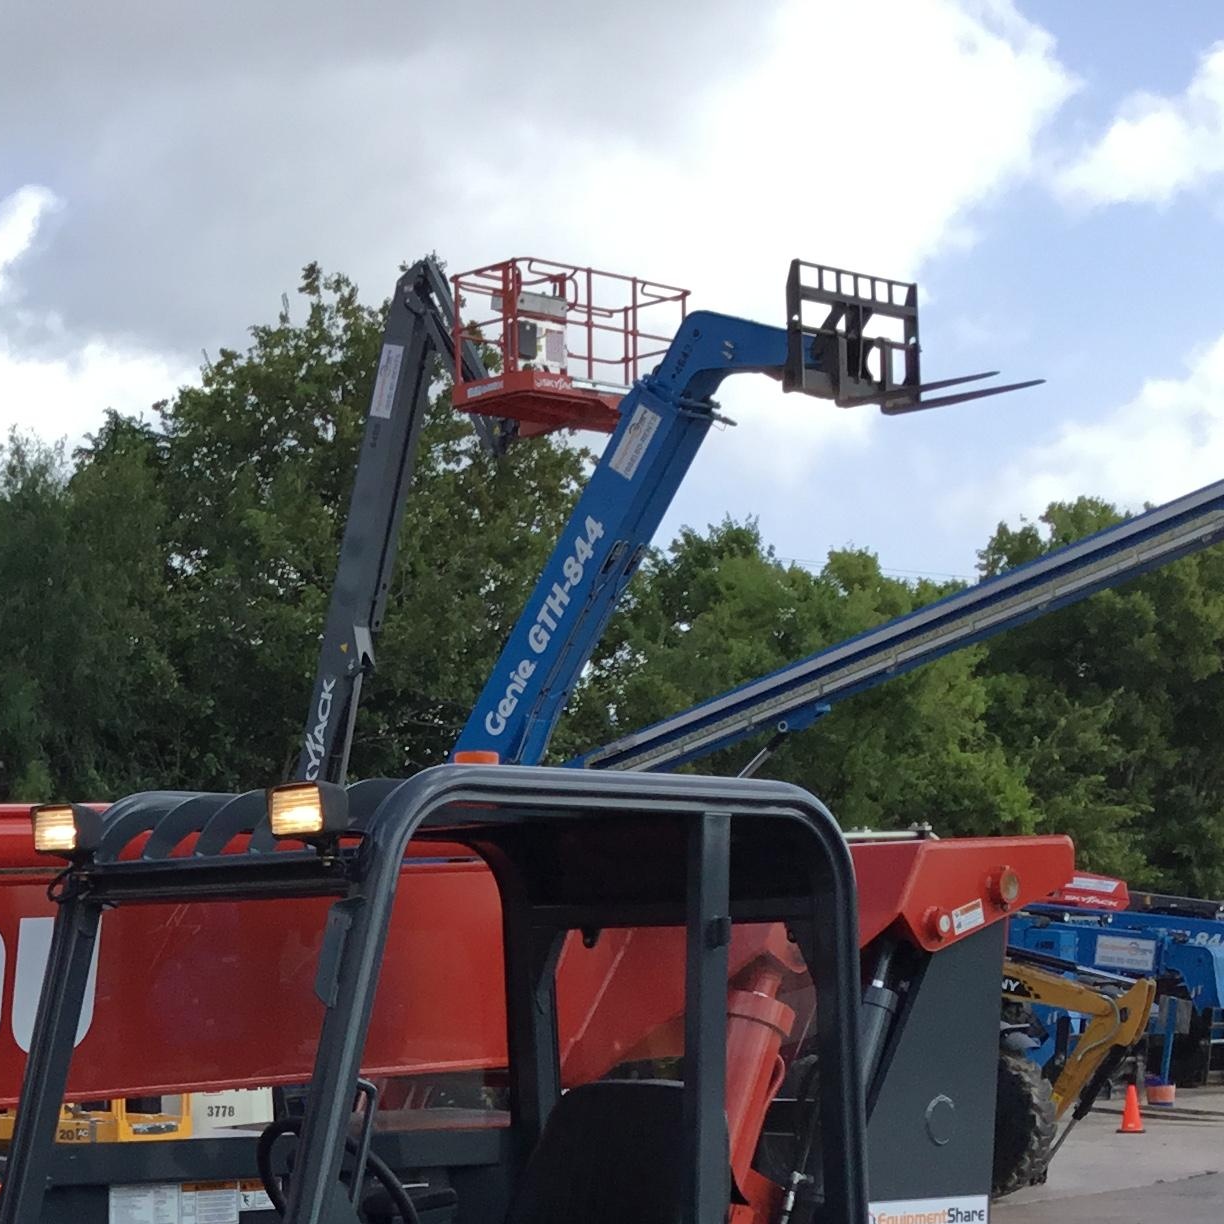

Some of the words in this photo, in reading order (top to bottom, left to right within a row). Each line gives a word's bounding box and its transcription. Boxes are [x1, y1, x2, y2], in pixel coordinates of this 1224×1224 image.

[485, 659, 537, 736] Genie
[529, 515, 604, 654] GTH-844
[207, 1105, 235, 1117] 3778
